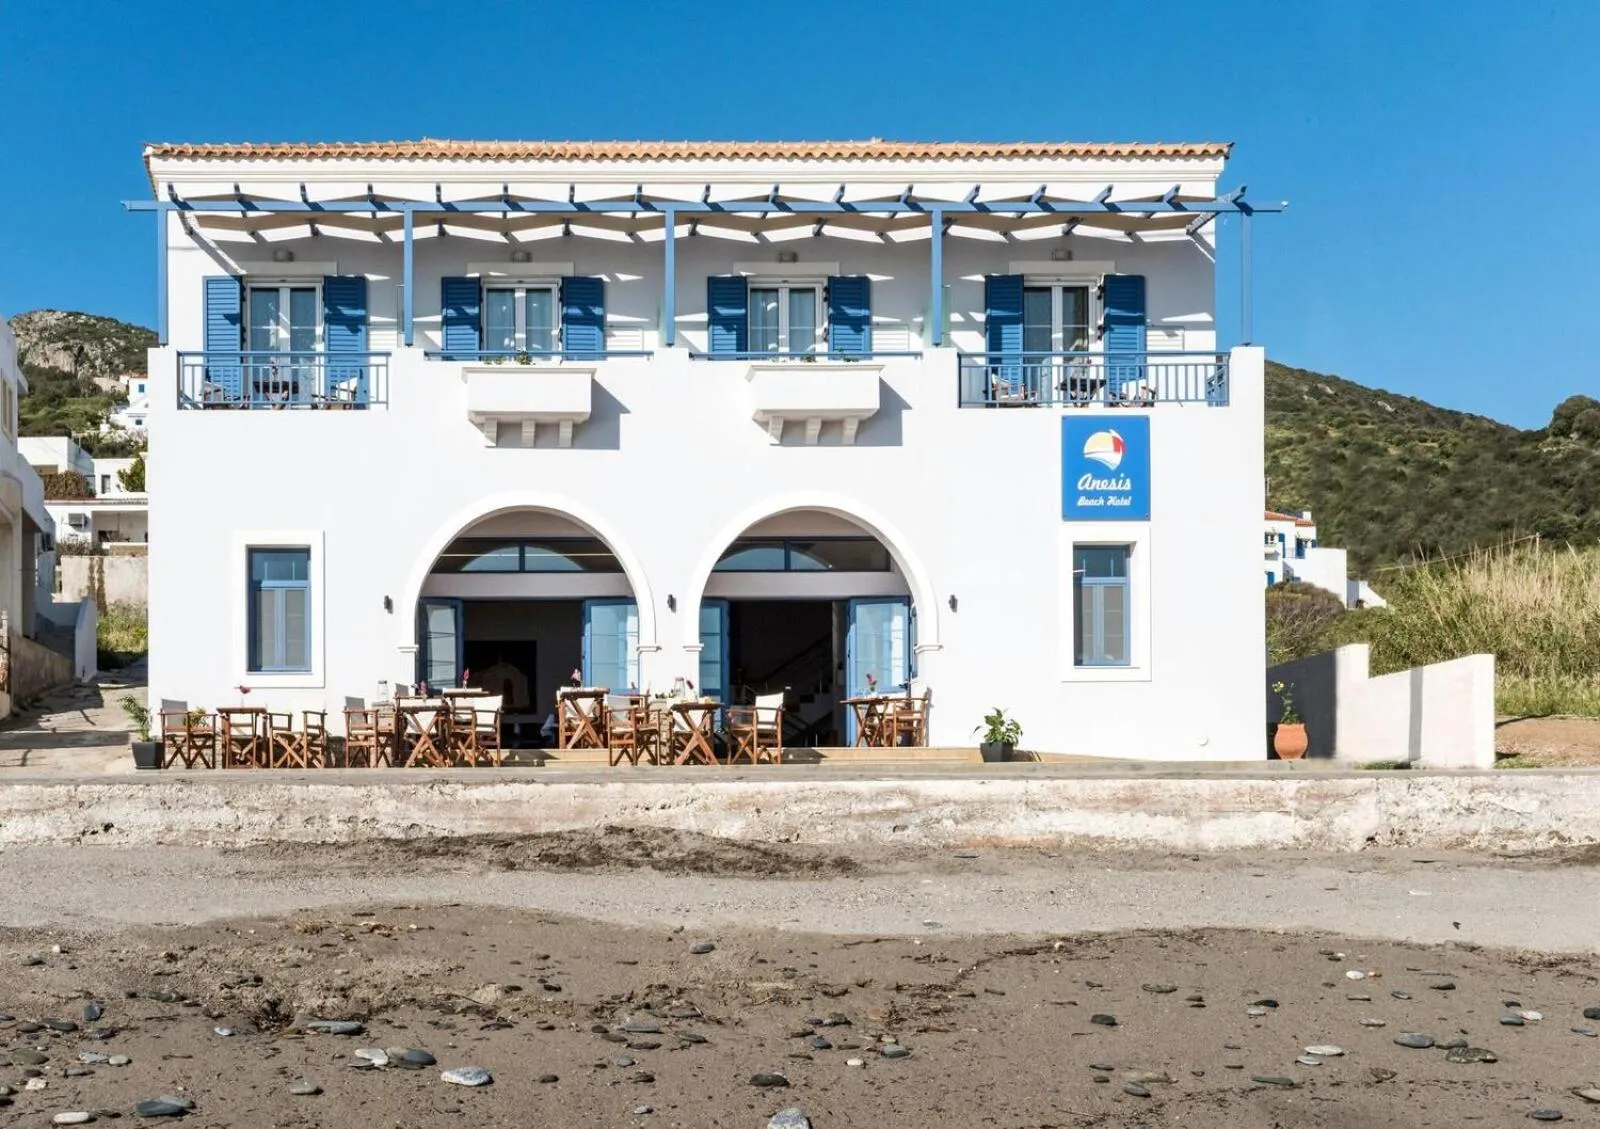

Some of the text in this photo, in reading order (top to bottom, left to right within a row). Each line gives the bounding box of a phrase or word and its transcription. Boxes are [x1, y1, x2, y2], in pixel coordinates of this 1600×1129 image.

[1077, 473, 1132, 490] Anesis
[1076, 496, 1132, 506] Beach Hotel
